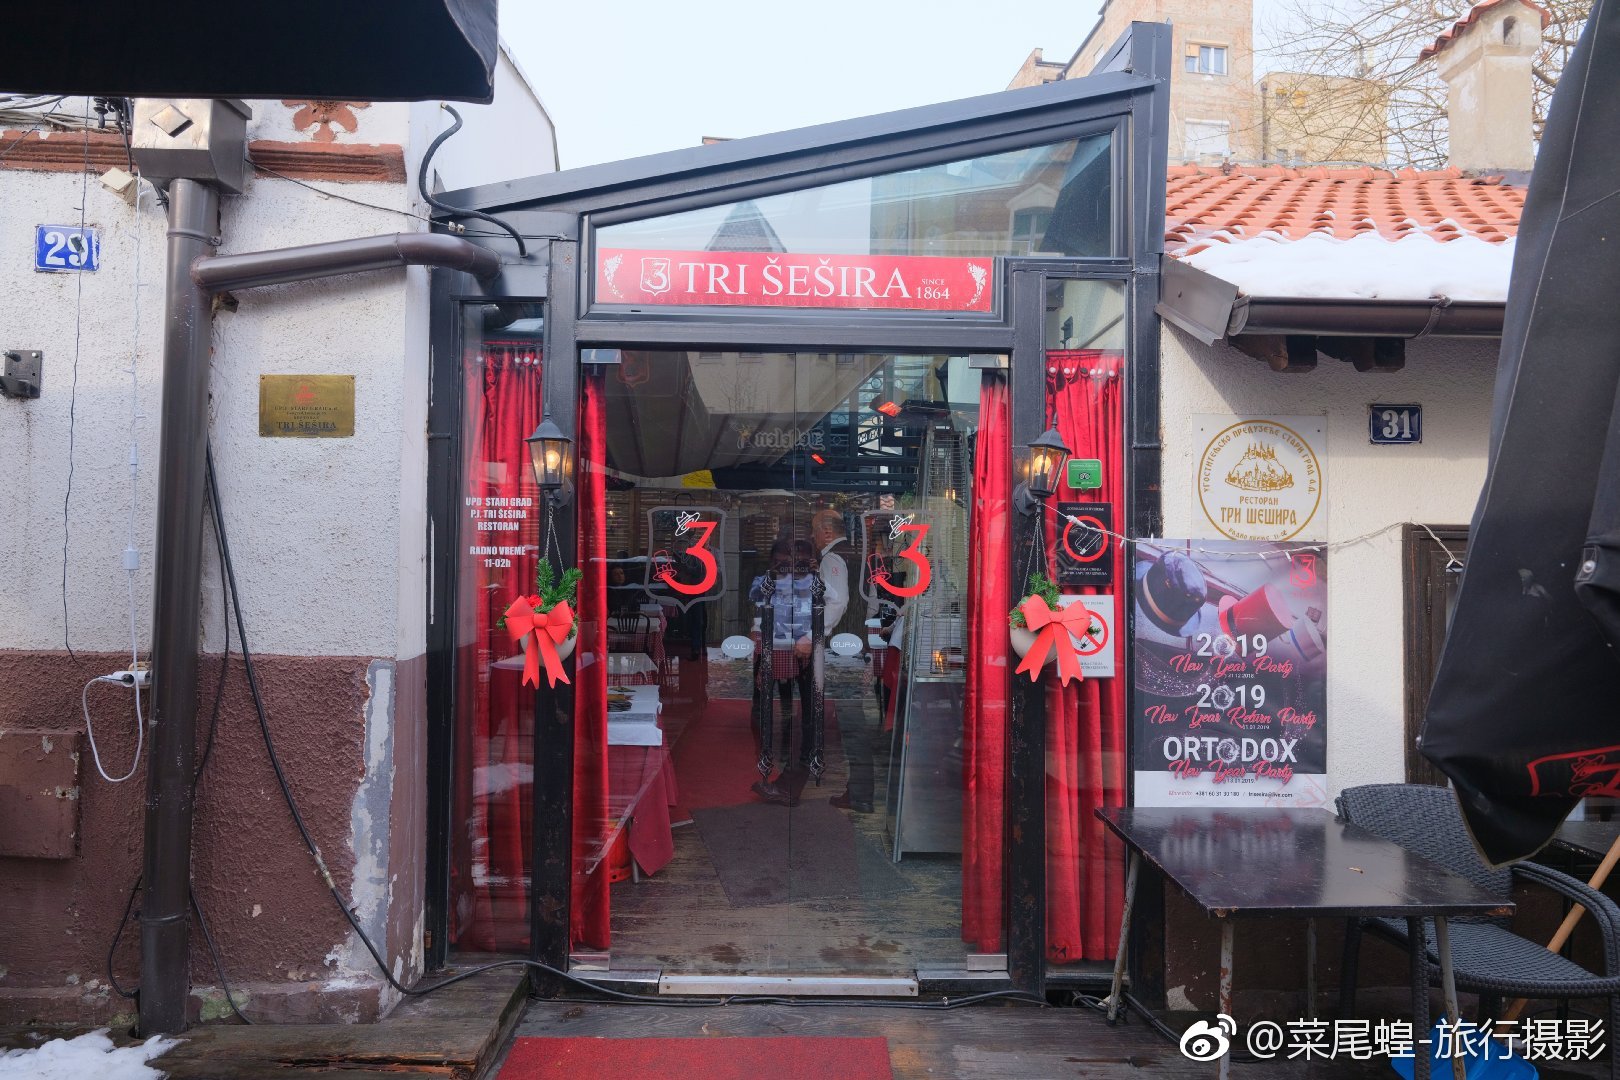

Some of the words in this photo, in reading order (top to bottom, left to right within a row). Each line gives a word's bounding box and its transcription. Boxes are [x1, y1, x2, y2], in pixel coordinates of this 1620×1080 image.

[45, 231, 88, 266] 29
[678, 261, 748, 295] TRI
[761, 256, 913, 299] ŠEŠIRA
[920, 278, 946, 286] SINCE
[914, 286, 951, 300] 1864
[276, 421, 295, 430] TRI
[298, 419, 337, 430] ŠEŠIRA
[1382, 409, 1412, 439] 31
[1281, 432, 1305, 454] СТАРИ
[1302, 453, 1315, 476] ГРАД
[484, 510, 497, 519] TRI
[498, 507, 527, 519] ŠEŠIRA
[485, 497, 509, 507] STARI
[510, 498, 532, 507] GRAD
[1239, 495, 1279, 506] РЕСТОРАН
[477, 521, 520, 531] RESTORAN
[1220, 506, 1241, 524] ТРИ
[1246, 508, 1297, 525] ШЕШИРА
[469, 546, 498, 555] RADNO
[499, 546, 526, 556] VREME
[484, 558, 511, 568] 11-02h
[662, 521, 718, 595] 3
[876, 524, 931, 598] 3
[1196, 633, 1268, 658] 2019
[1169, 653, 1204, 674] New
[1209, 655, 1247, 678] Year
[1252, 656, 1294, 679] Party
[1196, 684, 1266, 710] 2019
[1144, 704, 1179, 724] New
[1184, 705, 1222, 729] Year
[1227, 706, 1272, 729] Return
[1276, 707, 1318, 729] Party
[1163, 736, 1299, 763] ORTODOX
[1168, 758, 1202, 779] New
[1208, 758, 1247, 784] Year
[1252, 760, 1294, 784] Party
